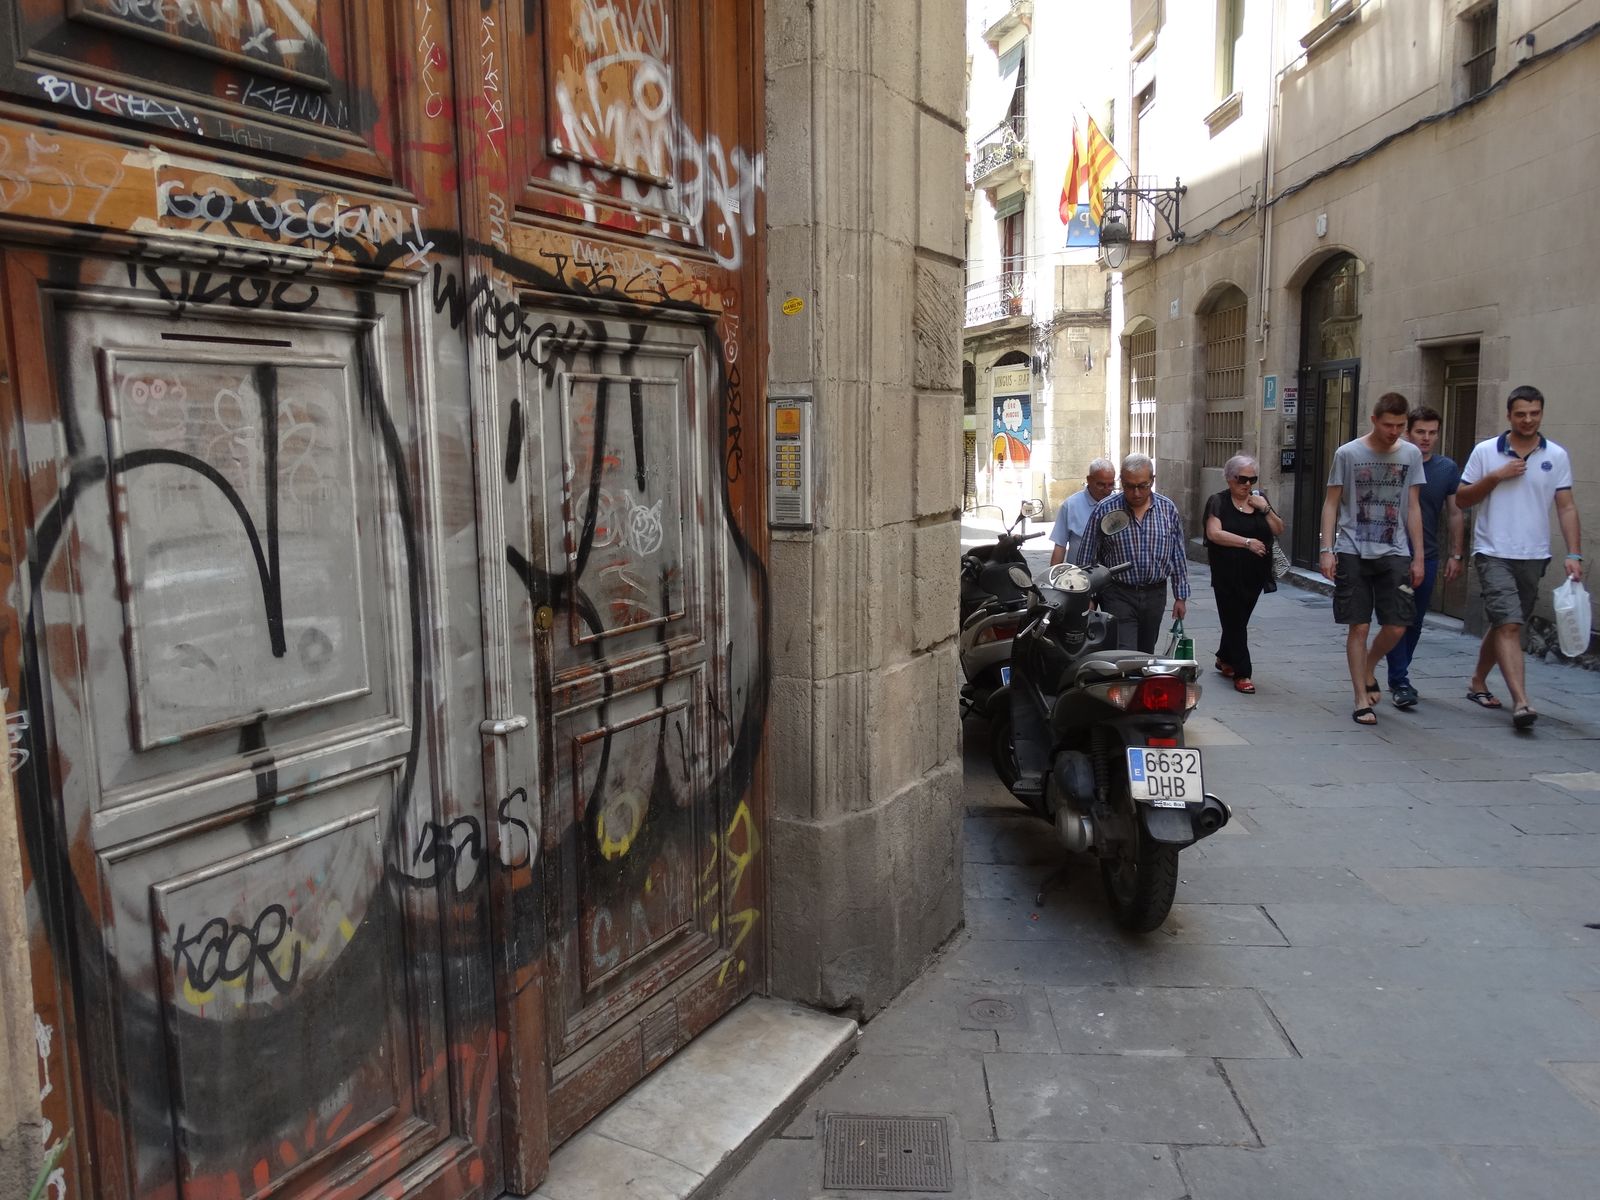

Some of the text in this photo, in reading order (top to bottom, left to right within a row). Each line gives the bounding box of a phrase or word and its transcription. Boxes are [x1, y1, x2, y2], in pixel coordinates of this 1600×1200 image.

[158, 180, 233, 222] GO
[1267, 380, 1273, 398] P
[1145, 752, 1197, 774] 6632
[1147, 775, 1186, 798] DHB
